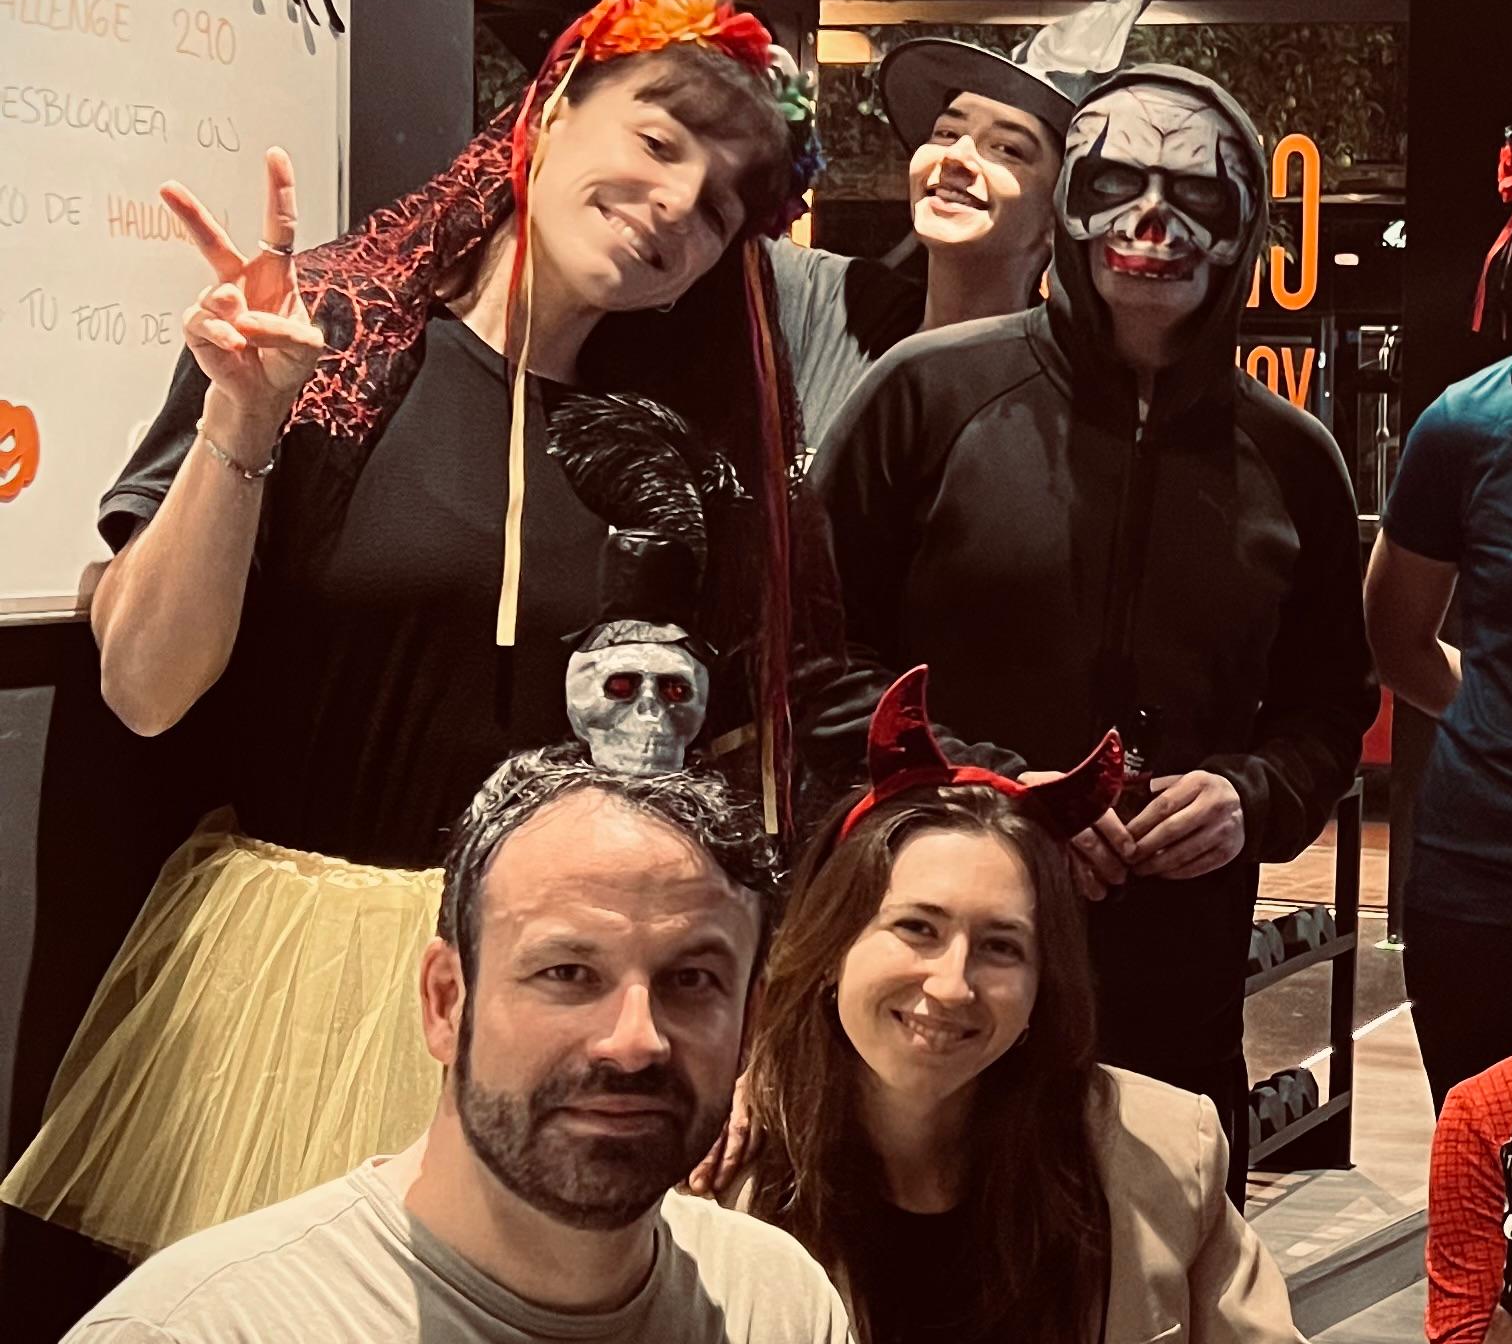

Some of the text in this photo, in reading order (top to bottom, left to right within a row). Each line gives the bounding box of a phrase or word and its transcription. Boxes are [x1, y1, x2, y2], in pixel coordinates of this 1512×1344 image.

[172, 8, 237, 65] 290
[44, 192, 82, 226] DE
[19, 288, 174, 345] TU FOTO DE
